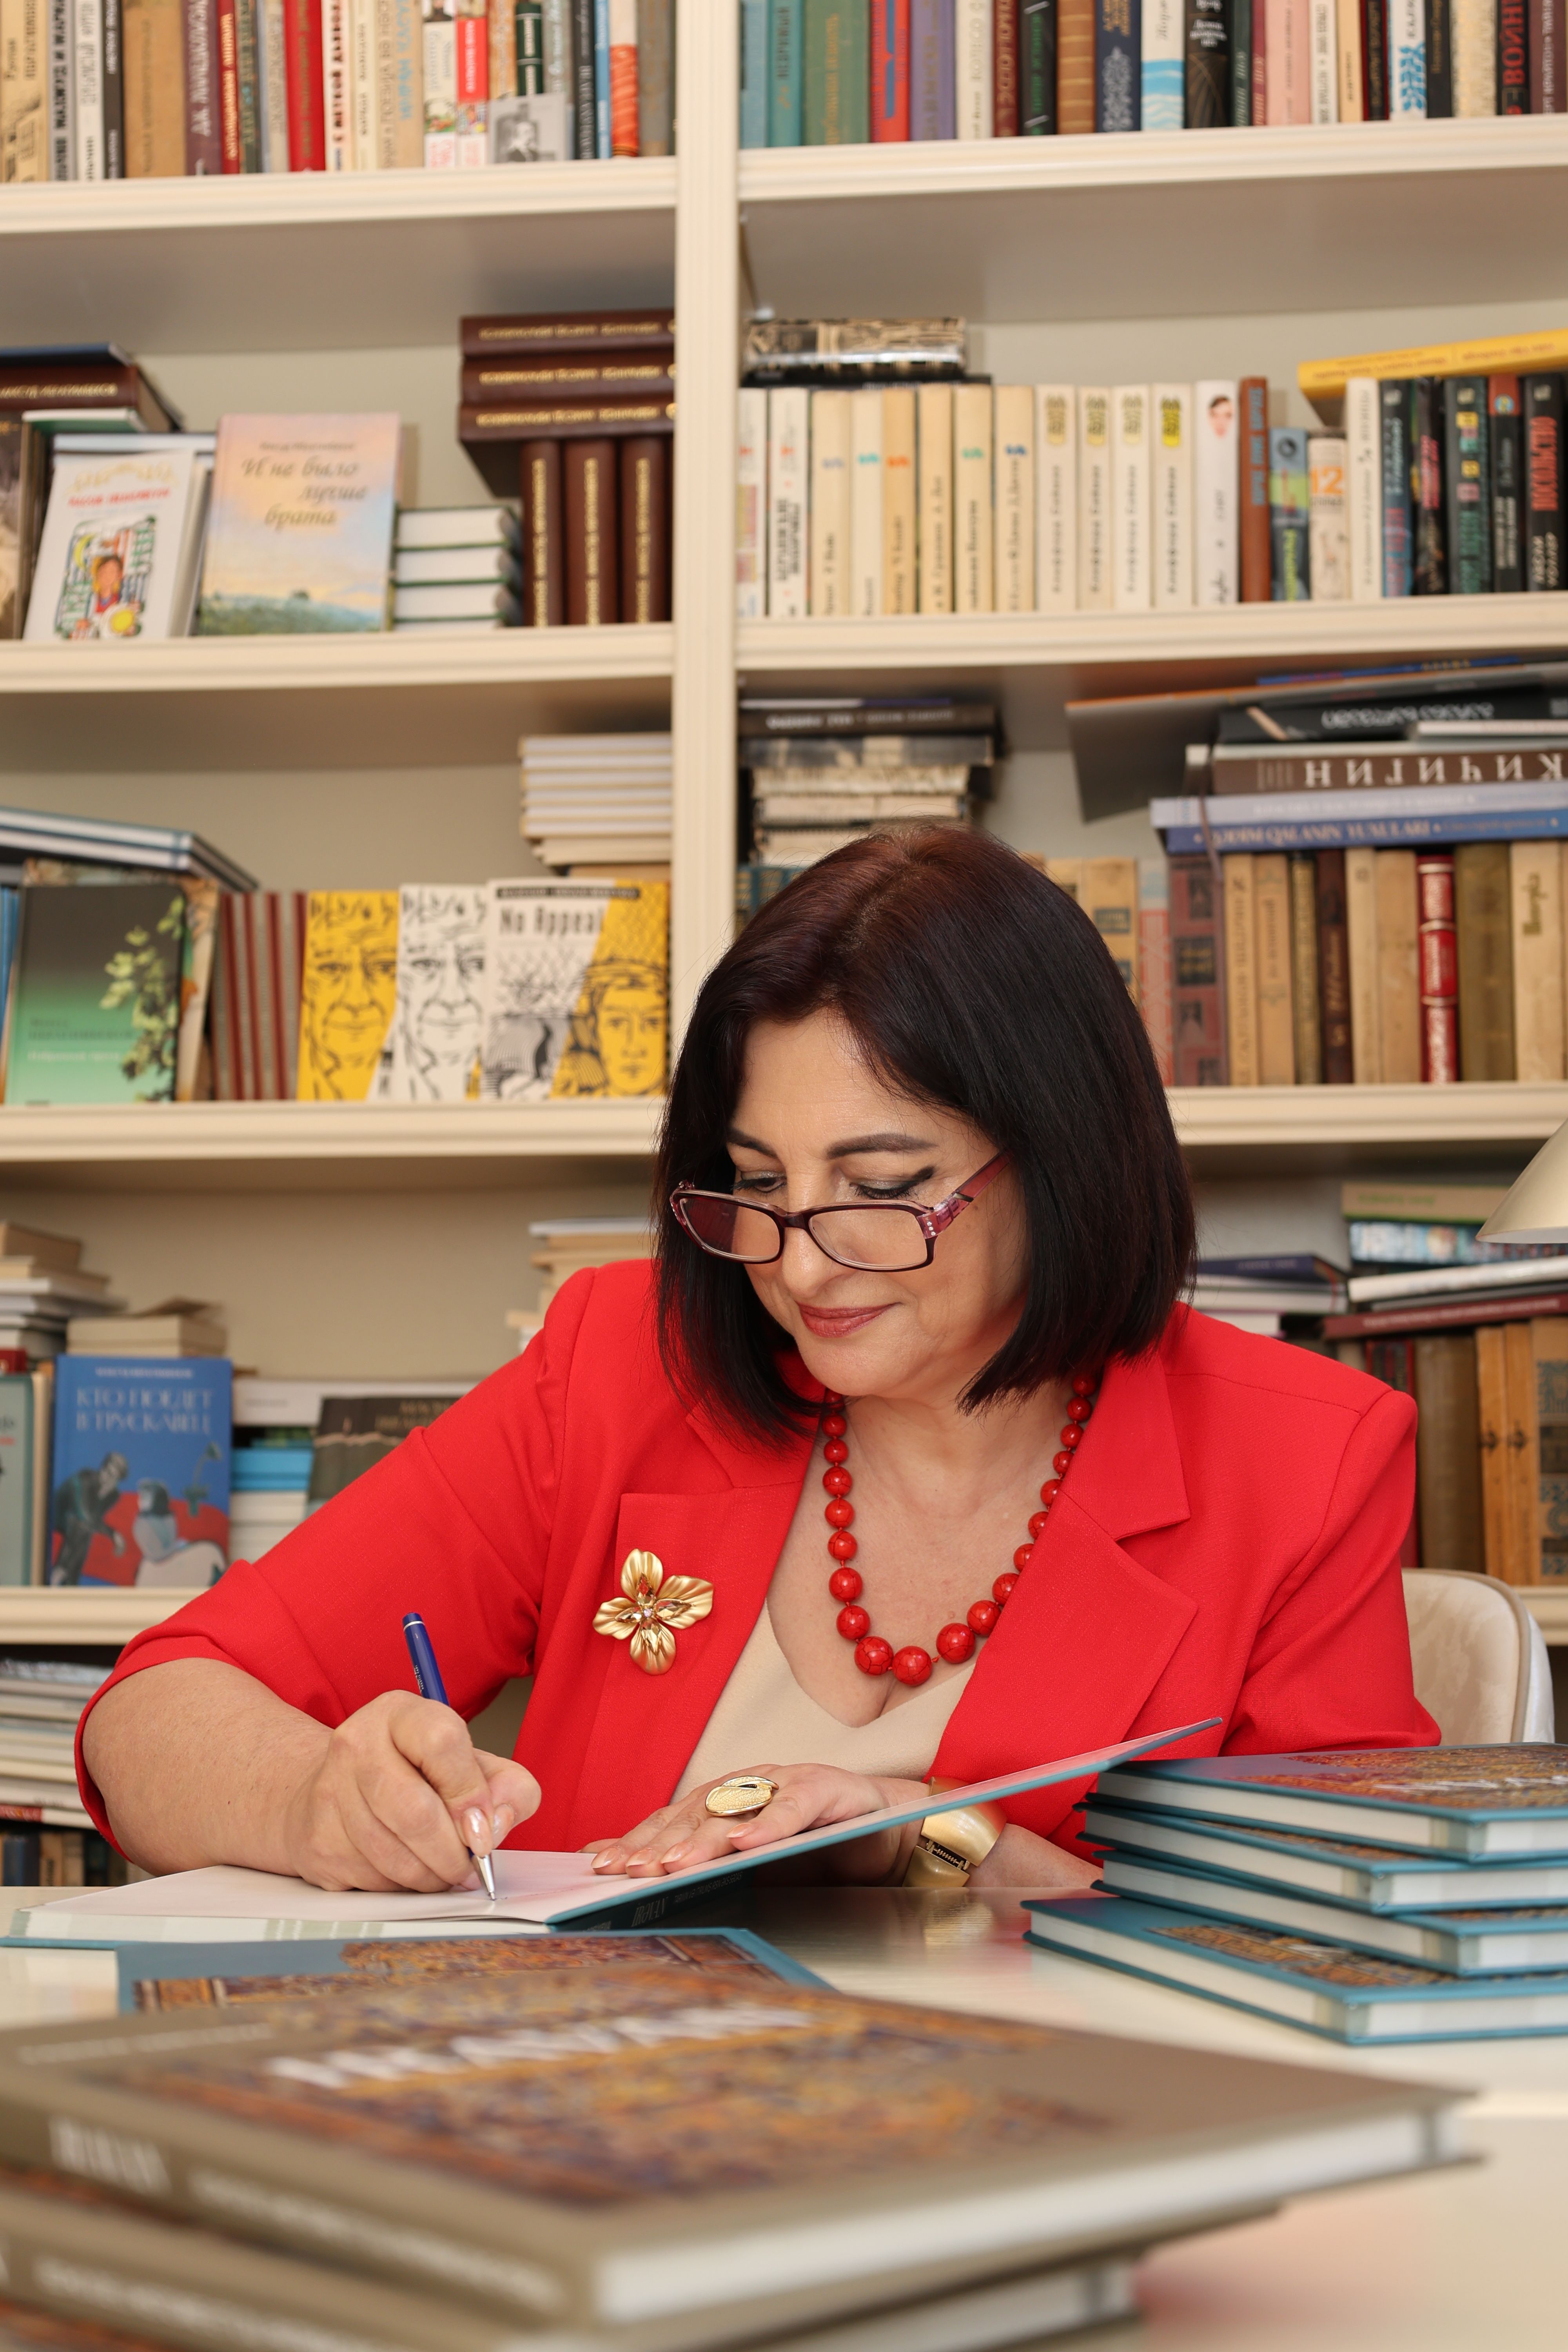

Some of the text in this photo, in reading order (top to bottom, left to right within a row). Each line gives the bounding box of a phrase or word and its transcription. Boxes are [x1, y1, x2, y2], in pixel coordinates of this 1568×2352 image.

[1499, 0, 1525, 85] ВОЙН
[240, 455, 359, 477] И не было
[1310, 466, 1344, 494] 12
[298, 485, 367, 504] лучше
[264, 503, 338, 531] брата
[500, 905, 605, 936] No Appeal
[76, 1386, 212, 1410] КТО ПОЕДЕТ
[75, 1410, 212, 1436] В ТРУСКАВЕЦ
